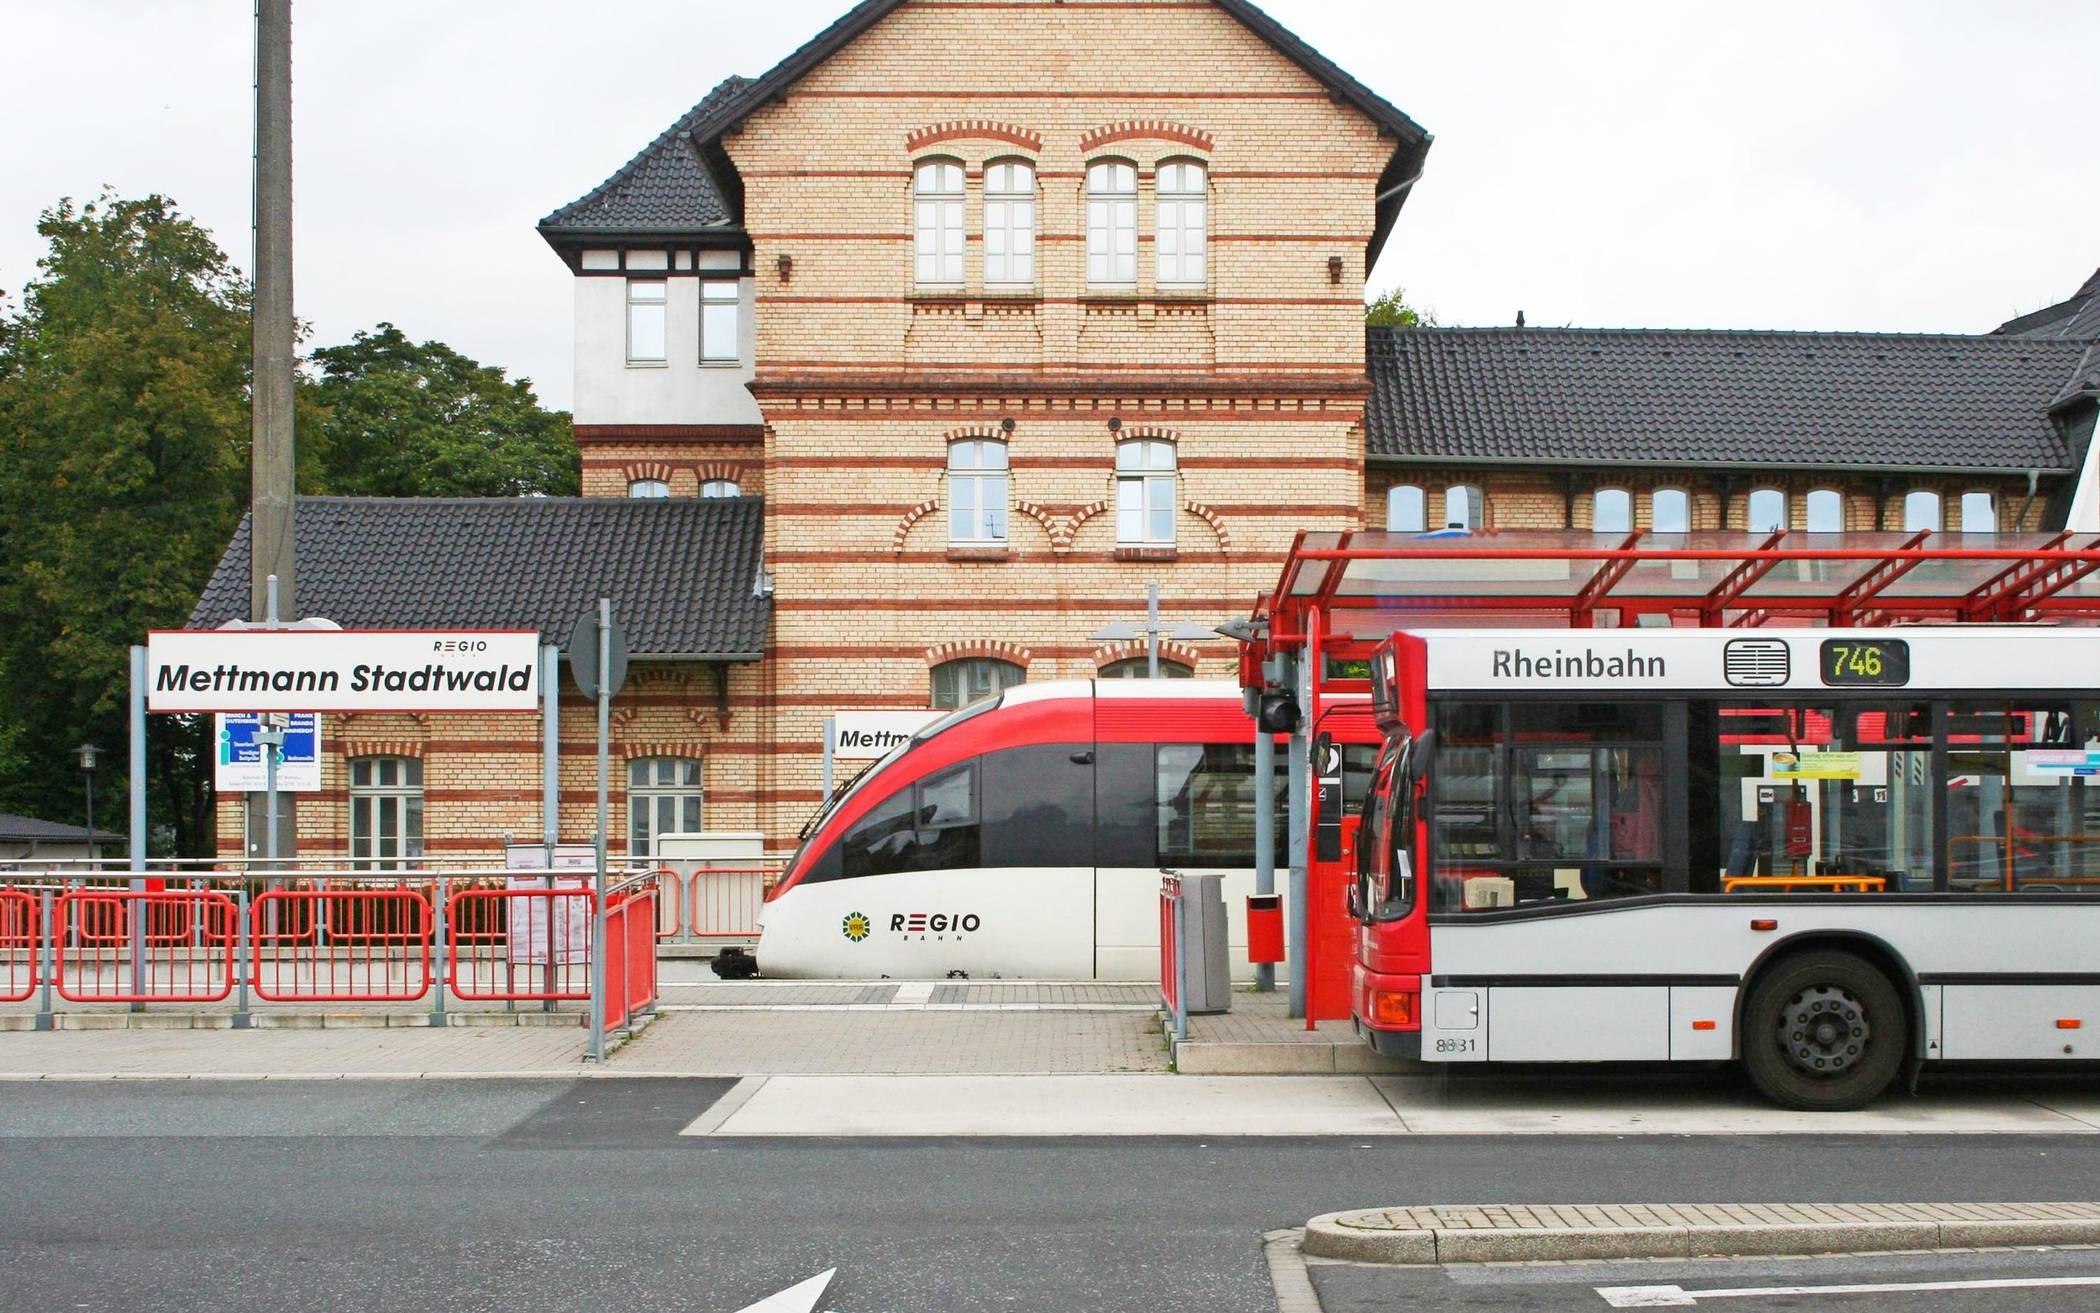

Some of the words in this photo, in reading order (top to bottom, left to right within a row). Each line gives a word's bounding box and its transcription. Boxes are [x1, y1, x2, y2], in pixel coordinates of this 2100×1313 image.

[433, 640, 487, 652] REGIO
[1493, 648, 1666, 678] Rheinbahn
[1833, 647, 1882, 676] 746
[156, 664, 340, 692] Mettmann
[350, 664, 532, 692] Stadtwald
[890, 913, 981, 932] REGIO
